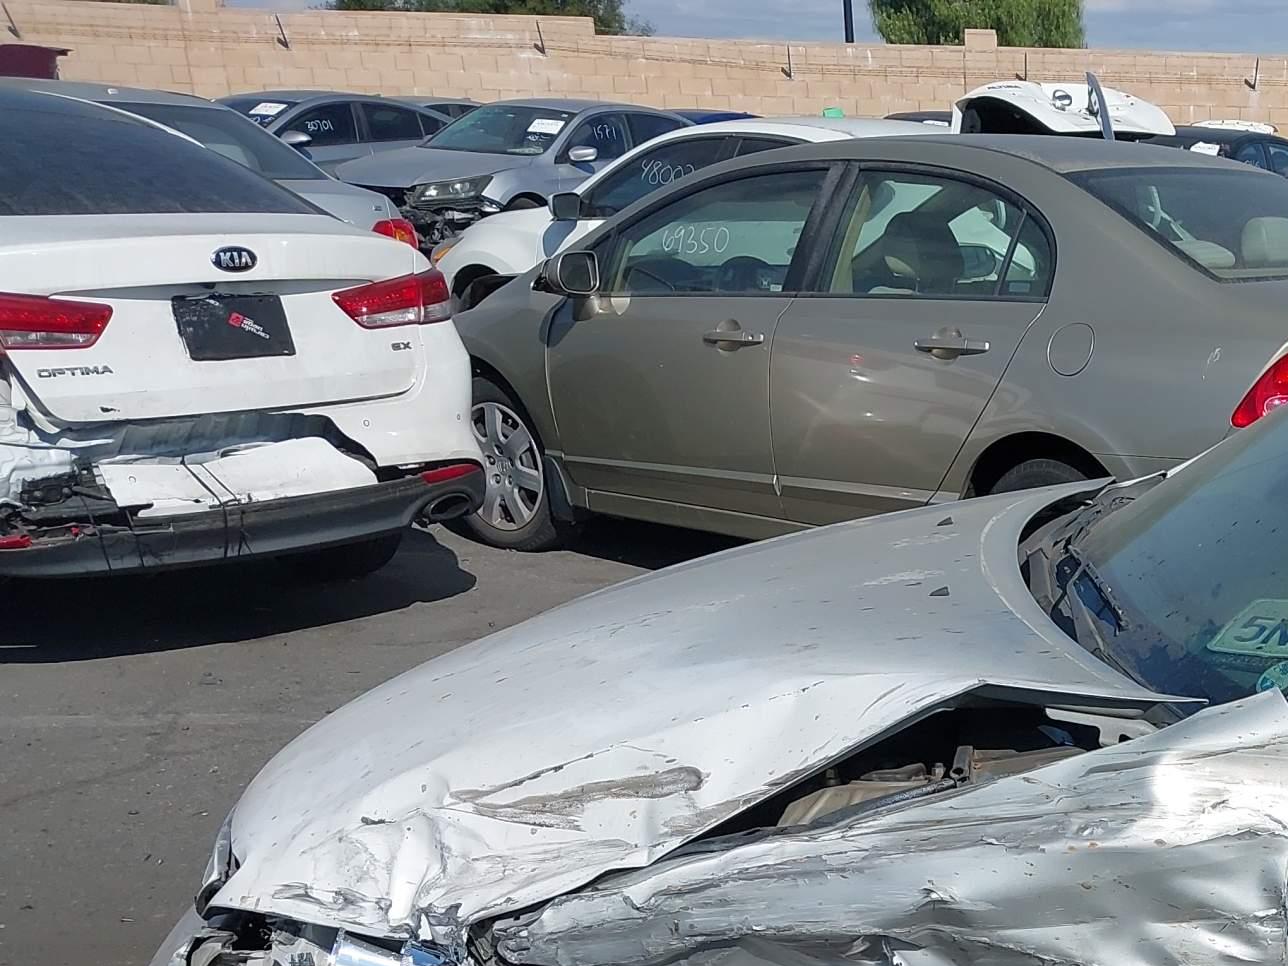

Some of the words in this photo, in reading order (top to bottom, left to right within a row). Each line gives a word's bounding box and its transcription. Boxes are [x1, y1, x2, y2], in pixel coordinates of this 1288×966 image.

[662, 225, 730, 254] 69350
[219, 250, 252, 268] KIA
[391, 341, 412, 351] EX
[36, 364, 114, 379] OPTIMA
